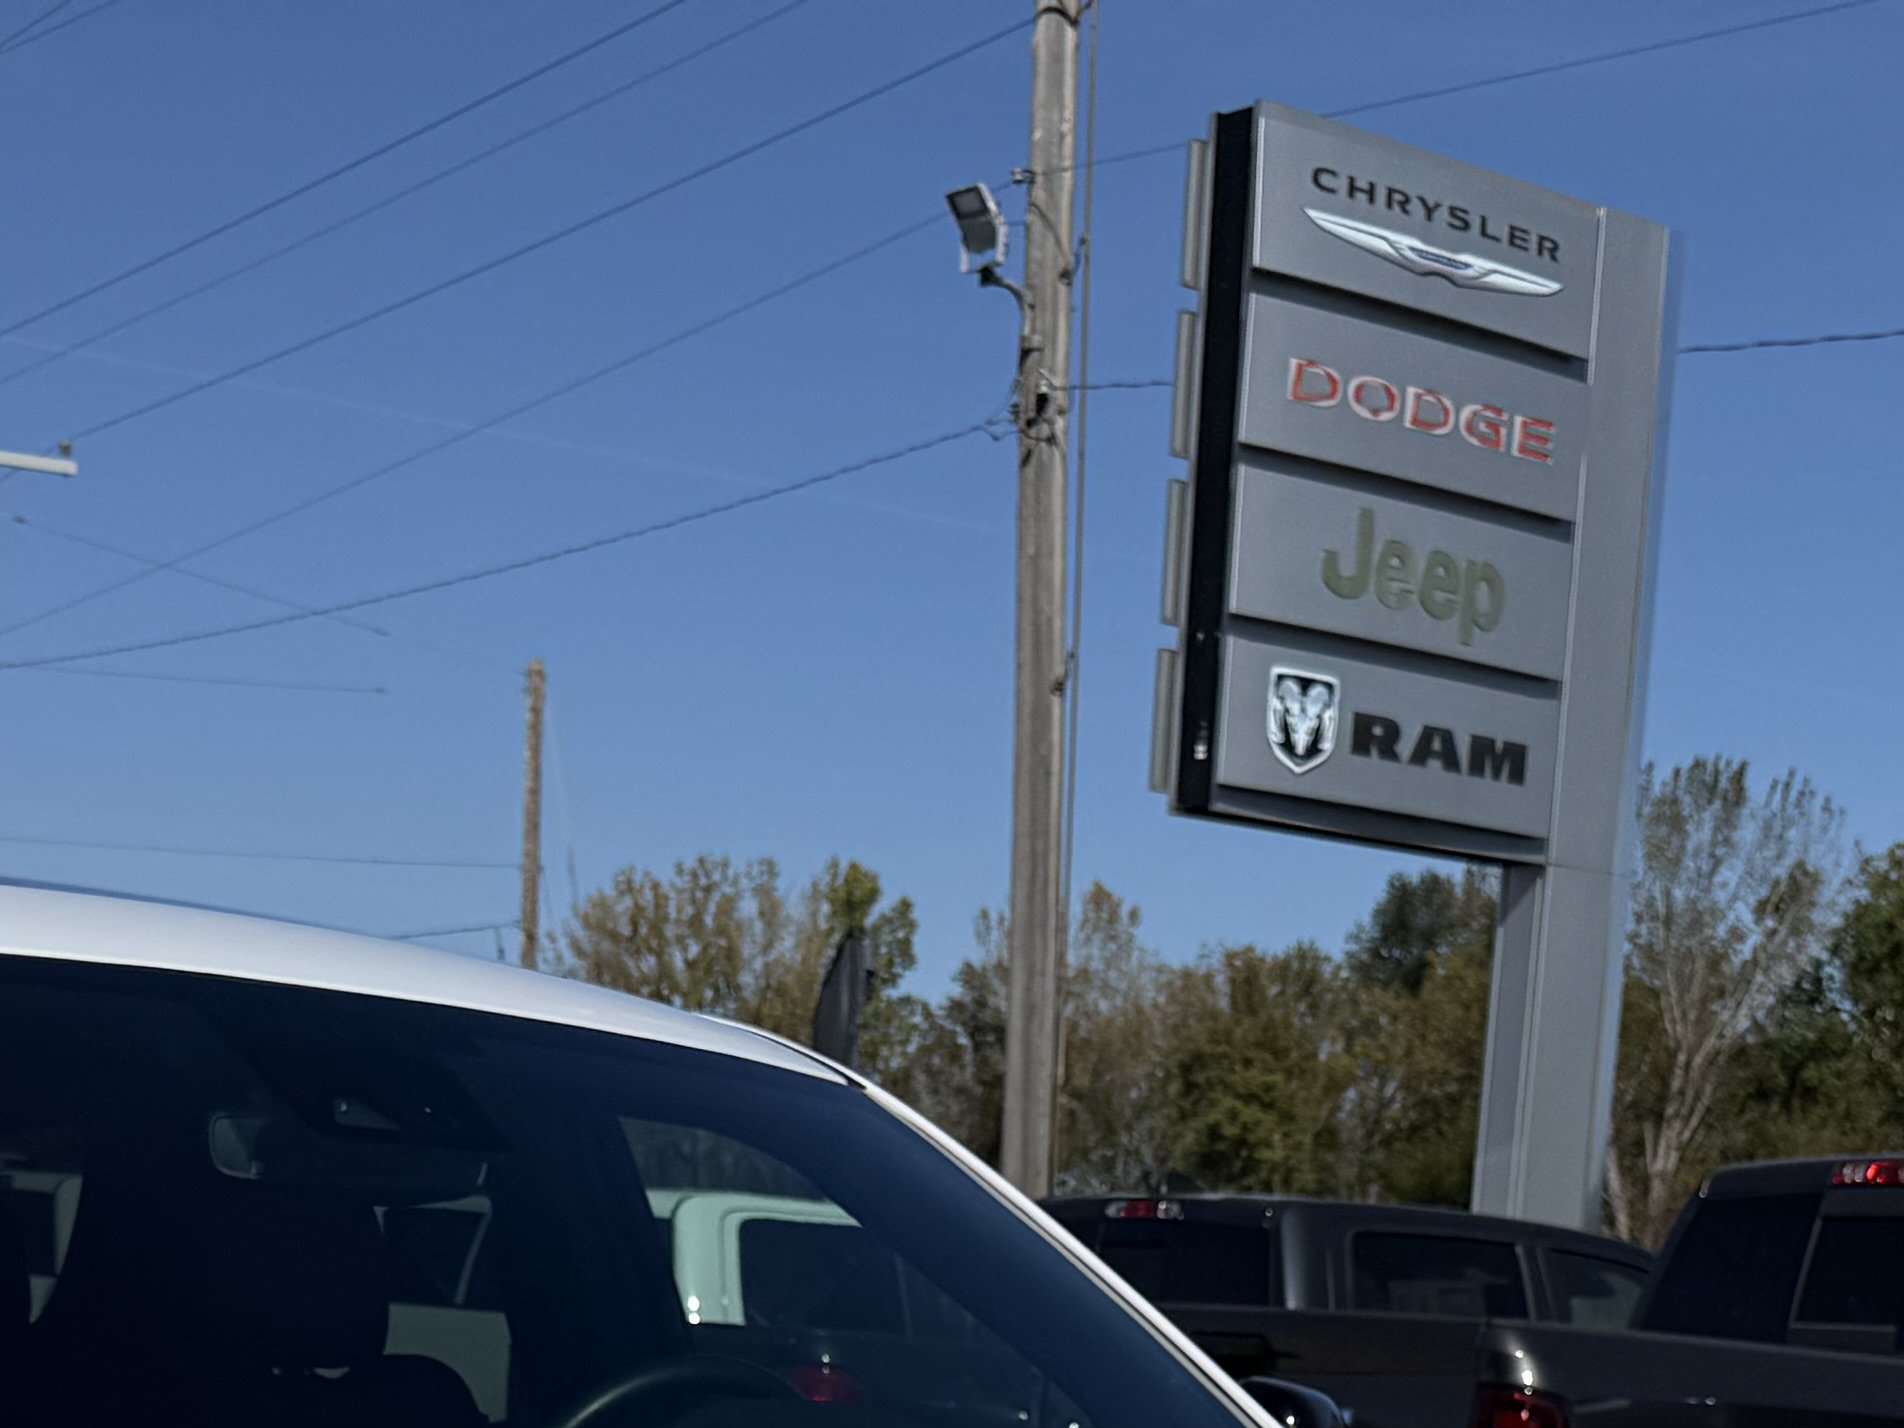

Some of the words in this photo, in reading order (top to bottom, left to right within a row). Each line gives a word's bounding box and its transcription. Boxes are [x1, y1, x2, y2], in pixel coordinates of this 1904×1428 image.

[1311, 167, 1562, 264] CHRYSLER
[1288, 358, 1555, 464] DODGE
[1322, 508, 1505, 646] Jeep
[1351, 712, 1527, 786] RAM
